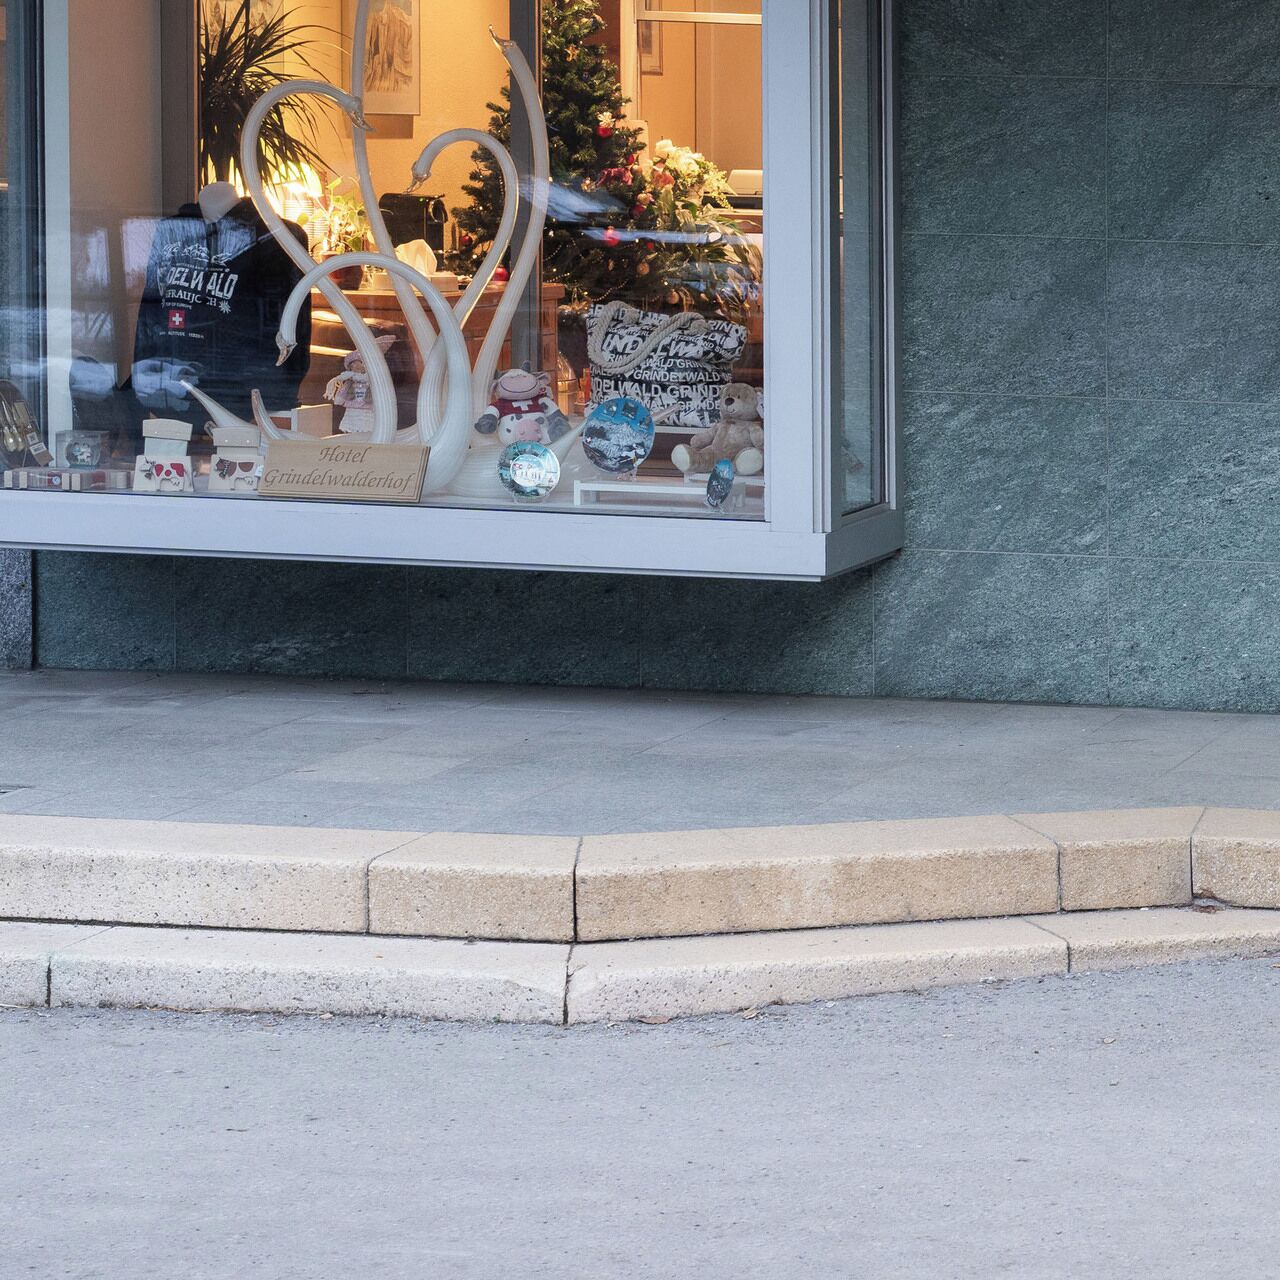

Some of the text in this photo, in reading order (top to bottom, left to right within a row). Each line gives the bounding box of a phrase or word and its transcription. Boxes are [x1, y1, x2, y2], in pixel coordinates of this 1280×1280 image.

[633, 370, 720, 383] GRINDELWALD
[319, 445, 373, 463] Hotel
[264, 467, 416, 495] Grindelwalderhof
